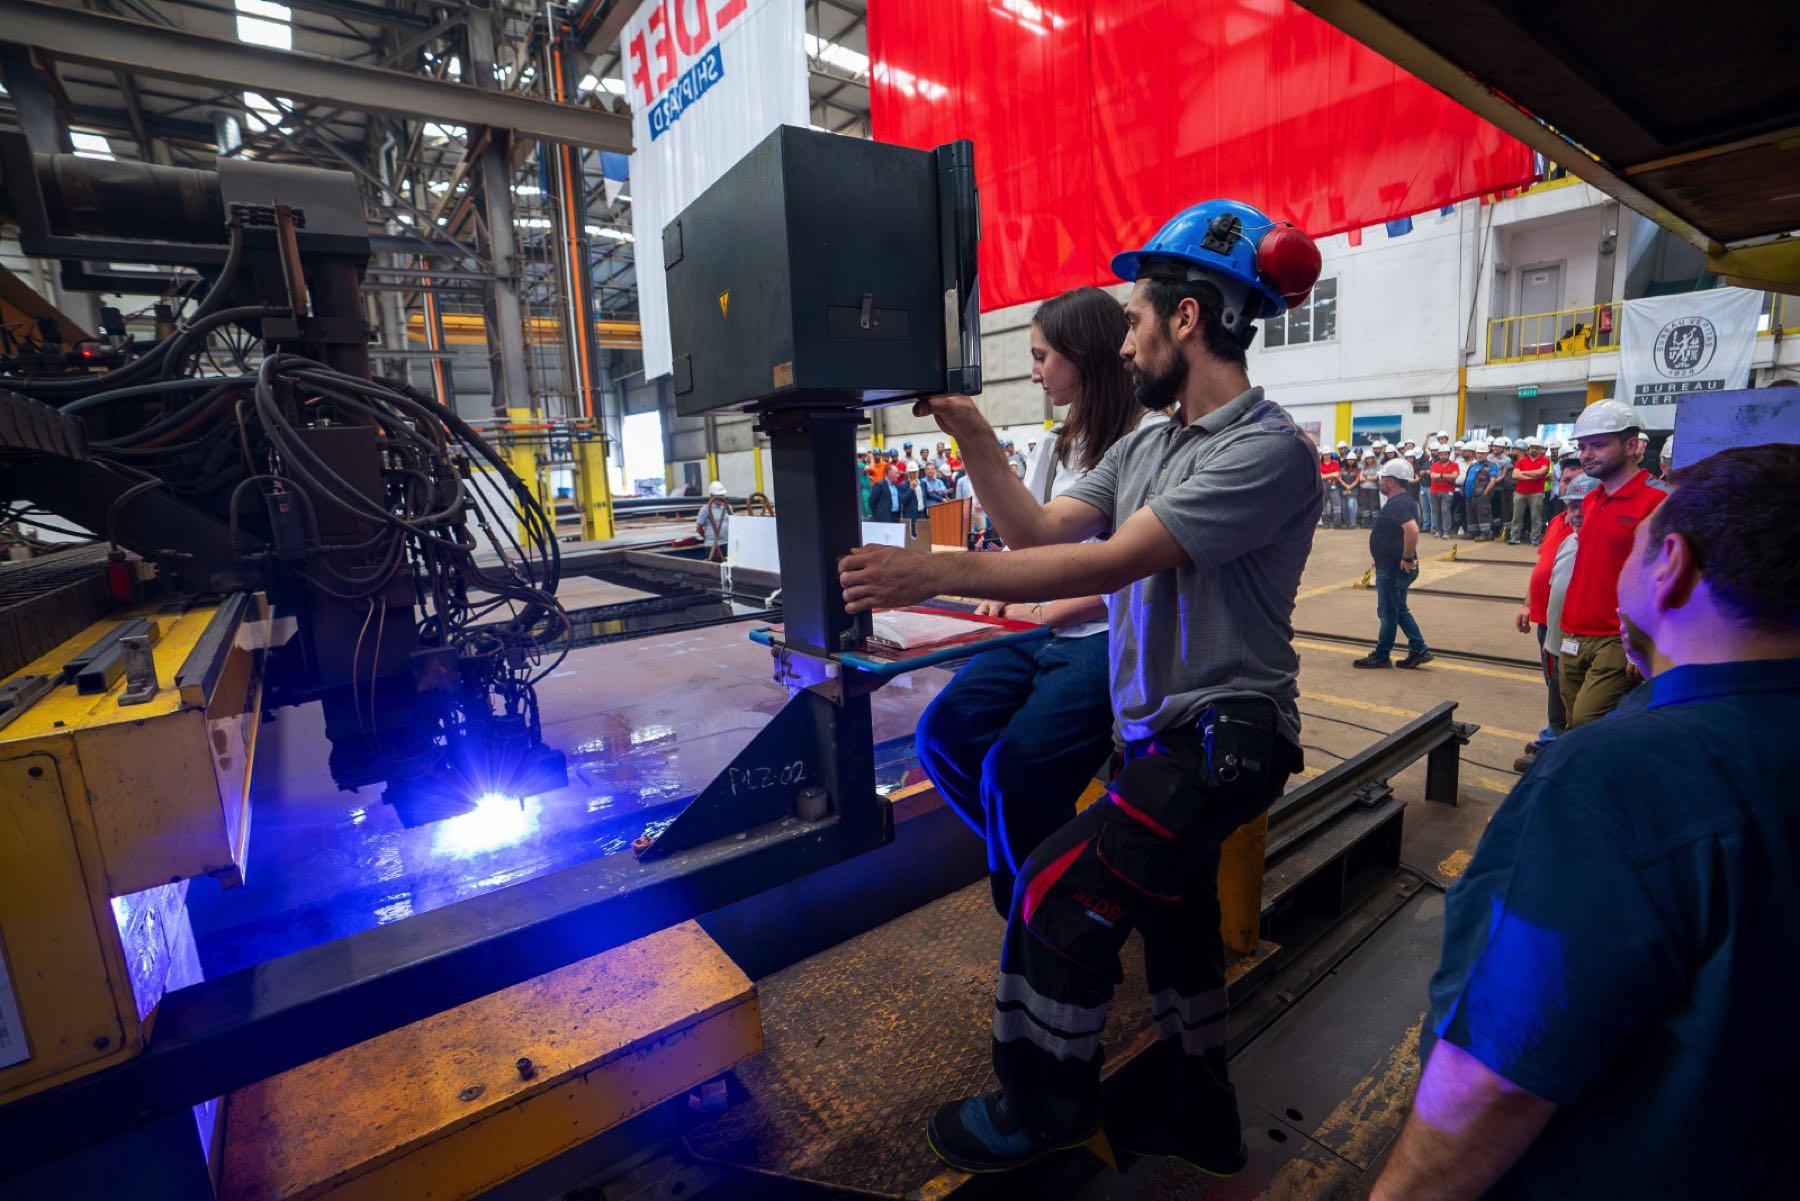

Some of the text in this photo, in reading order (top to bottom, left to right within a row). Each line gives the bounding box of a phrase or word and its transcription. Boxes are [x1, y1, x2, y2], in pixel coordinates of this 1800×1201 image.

[1656, 320, 1685, 352] BUREAU
[1642, 381, 1717, 393] BUREAU
[1640, 395, 1673, 405] VER
